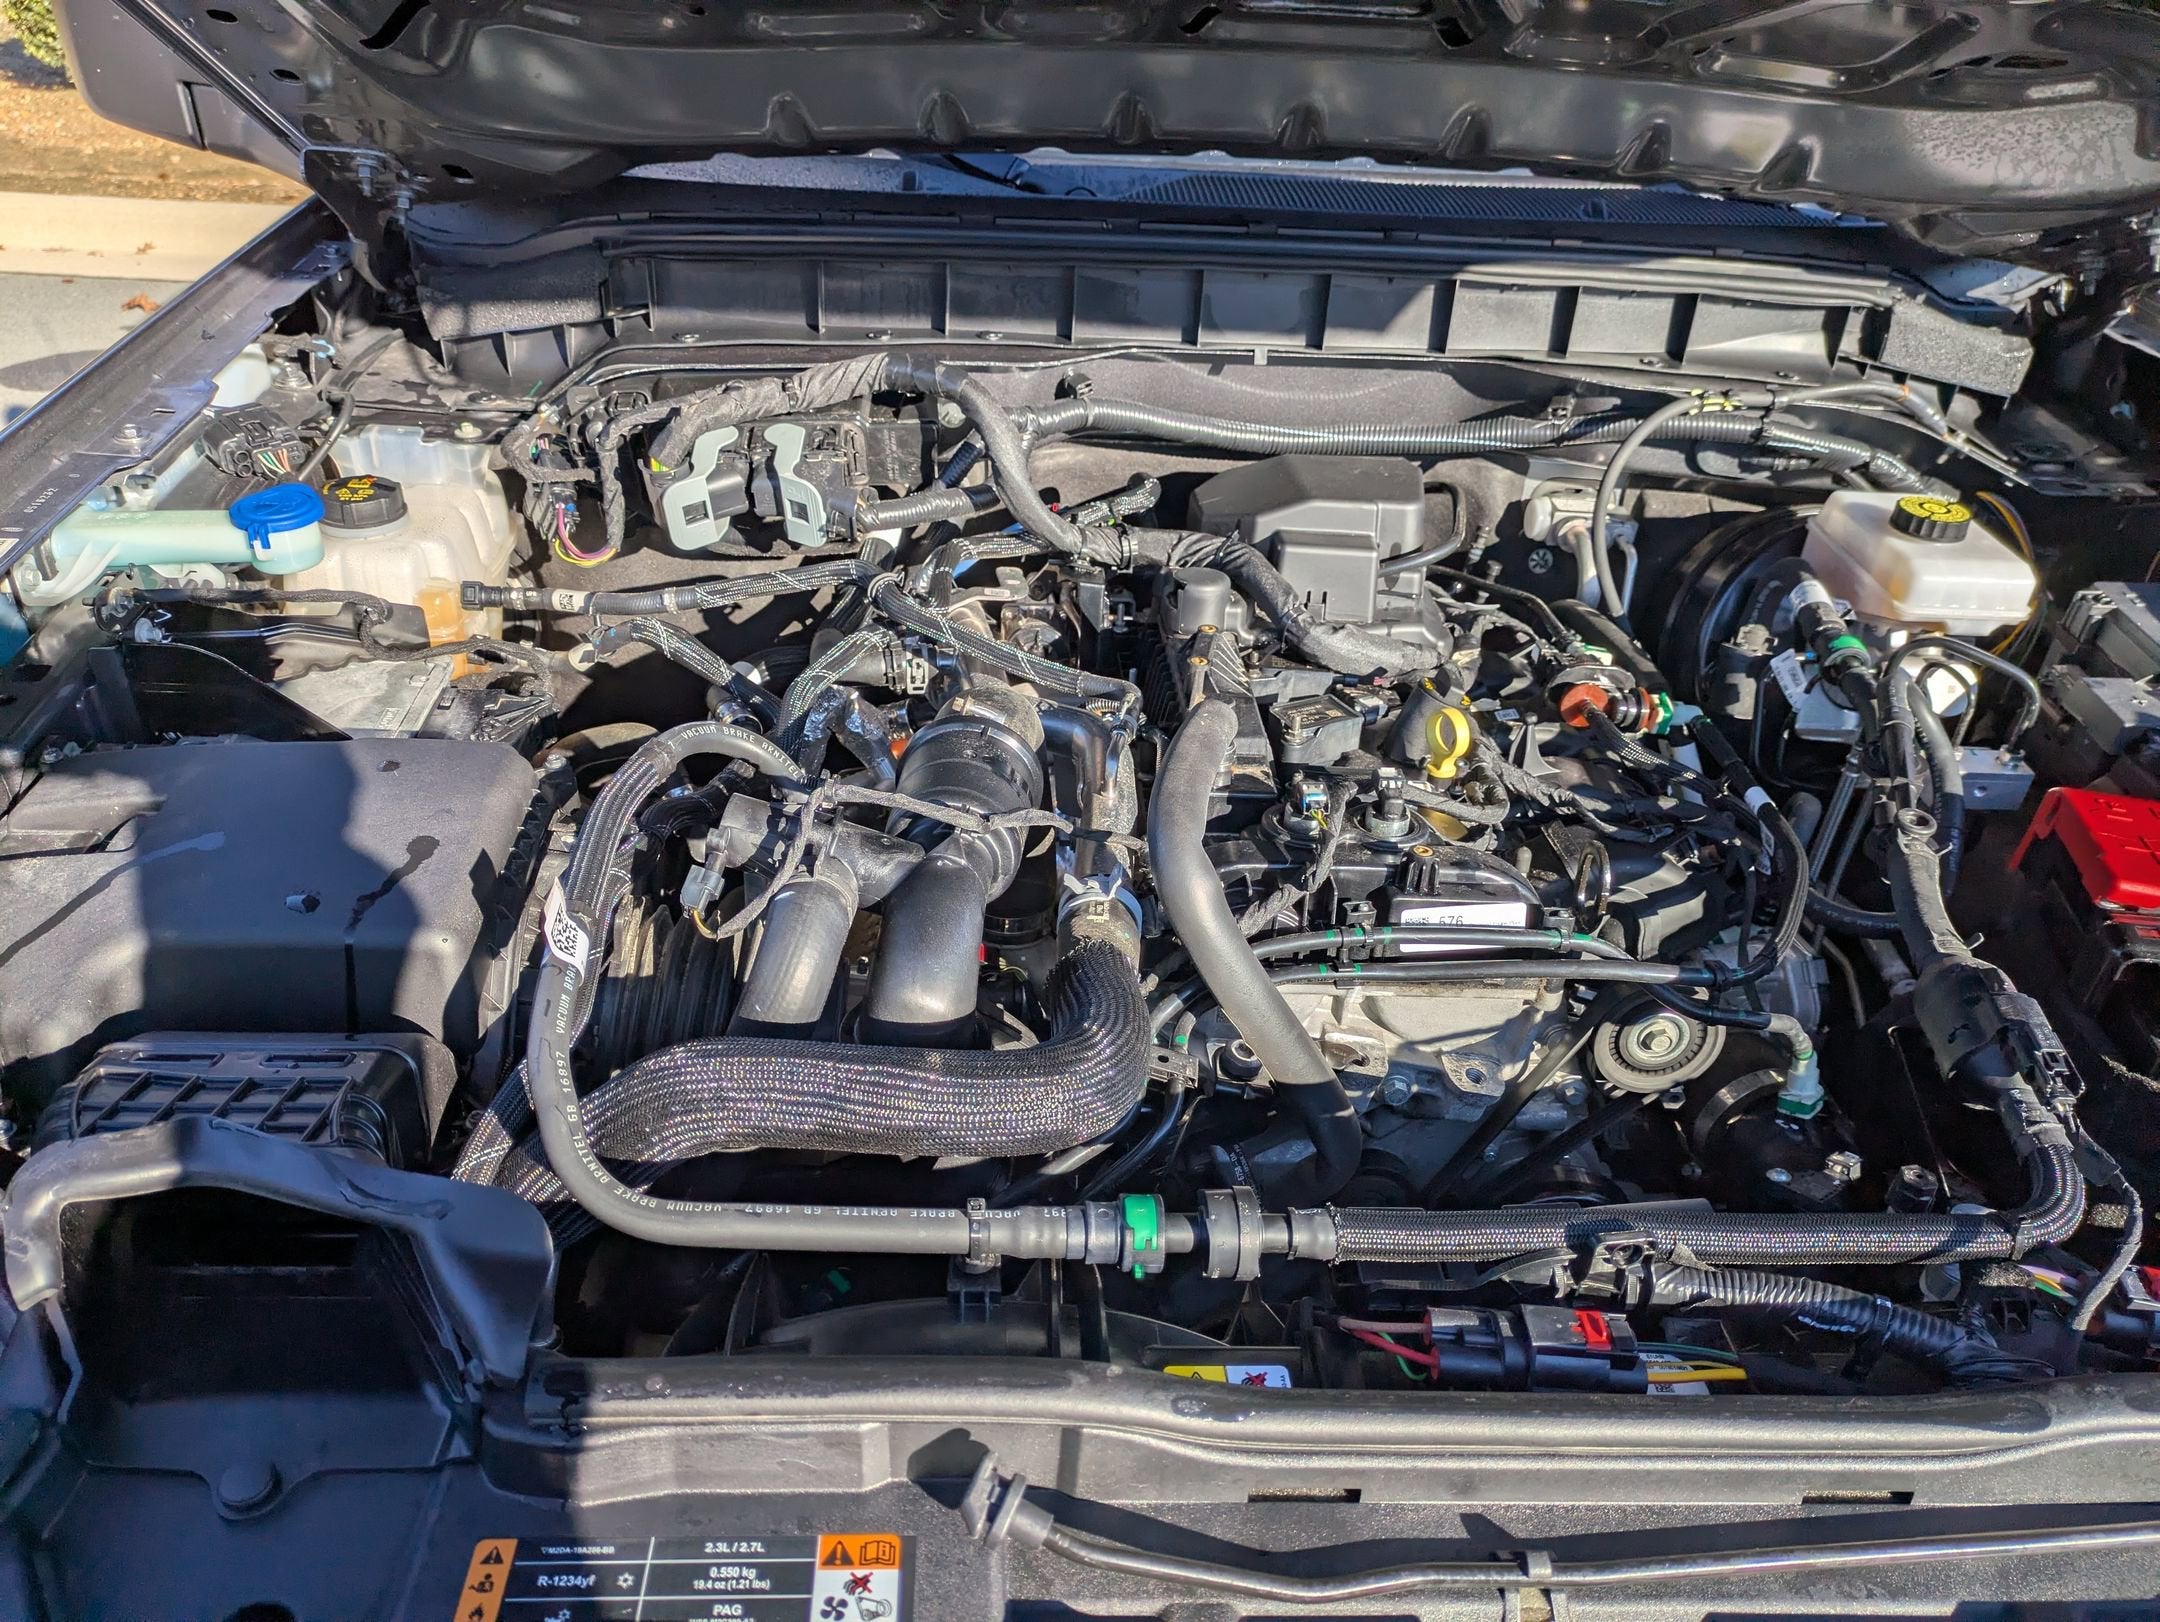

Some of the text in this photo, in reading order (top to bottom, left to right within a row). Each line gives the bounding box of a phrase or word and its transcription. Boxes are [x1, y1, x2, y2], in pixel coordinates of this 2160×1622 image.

[681, 725, 799, 779] VACUUM BRAKE ARNITEL
[563, 965, 577, 991] BRAK
[555, 995, 571, 1034] VACUUM
[556, 1051, 572, 1094] 16897
[567, 1105, 579, 1122] GB
[572, 1131, 609, 1184] ARNITEL
[613, 1187, 658, 1209] BRAKE
[667, 1201, 722, 1213] VACUUM
[910, 1209, 956, 1218] BRAKE
[984, 1210, 1021, 1219] VACU
[704, 1542, 765, 1553] 2.3L / 2.7L
[709, 1566, 757, 1580] 0.550 kg
[537, 1574, 597, 1588] R-1234yf
[693, 1578, 771, 1591] 19.4 oz (1.21 lbs)
[712, 1604, 743, 1616] PAG
